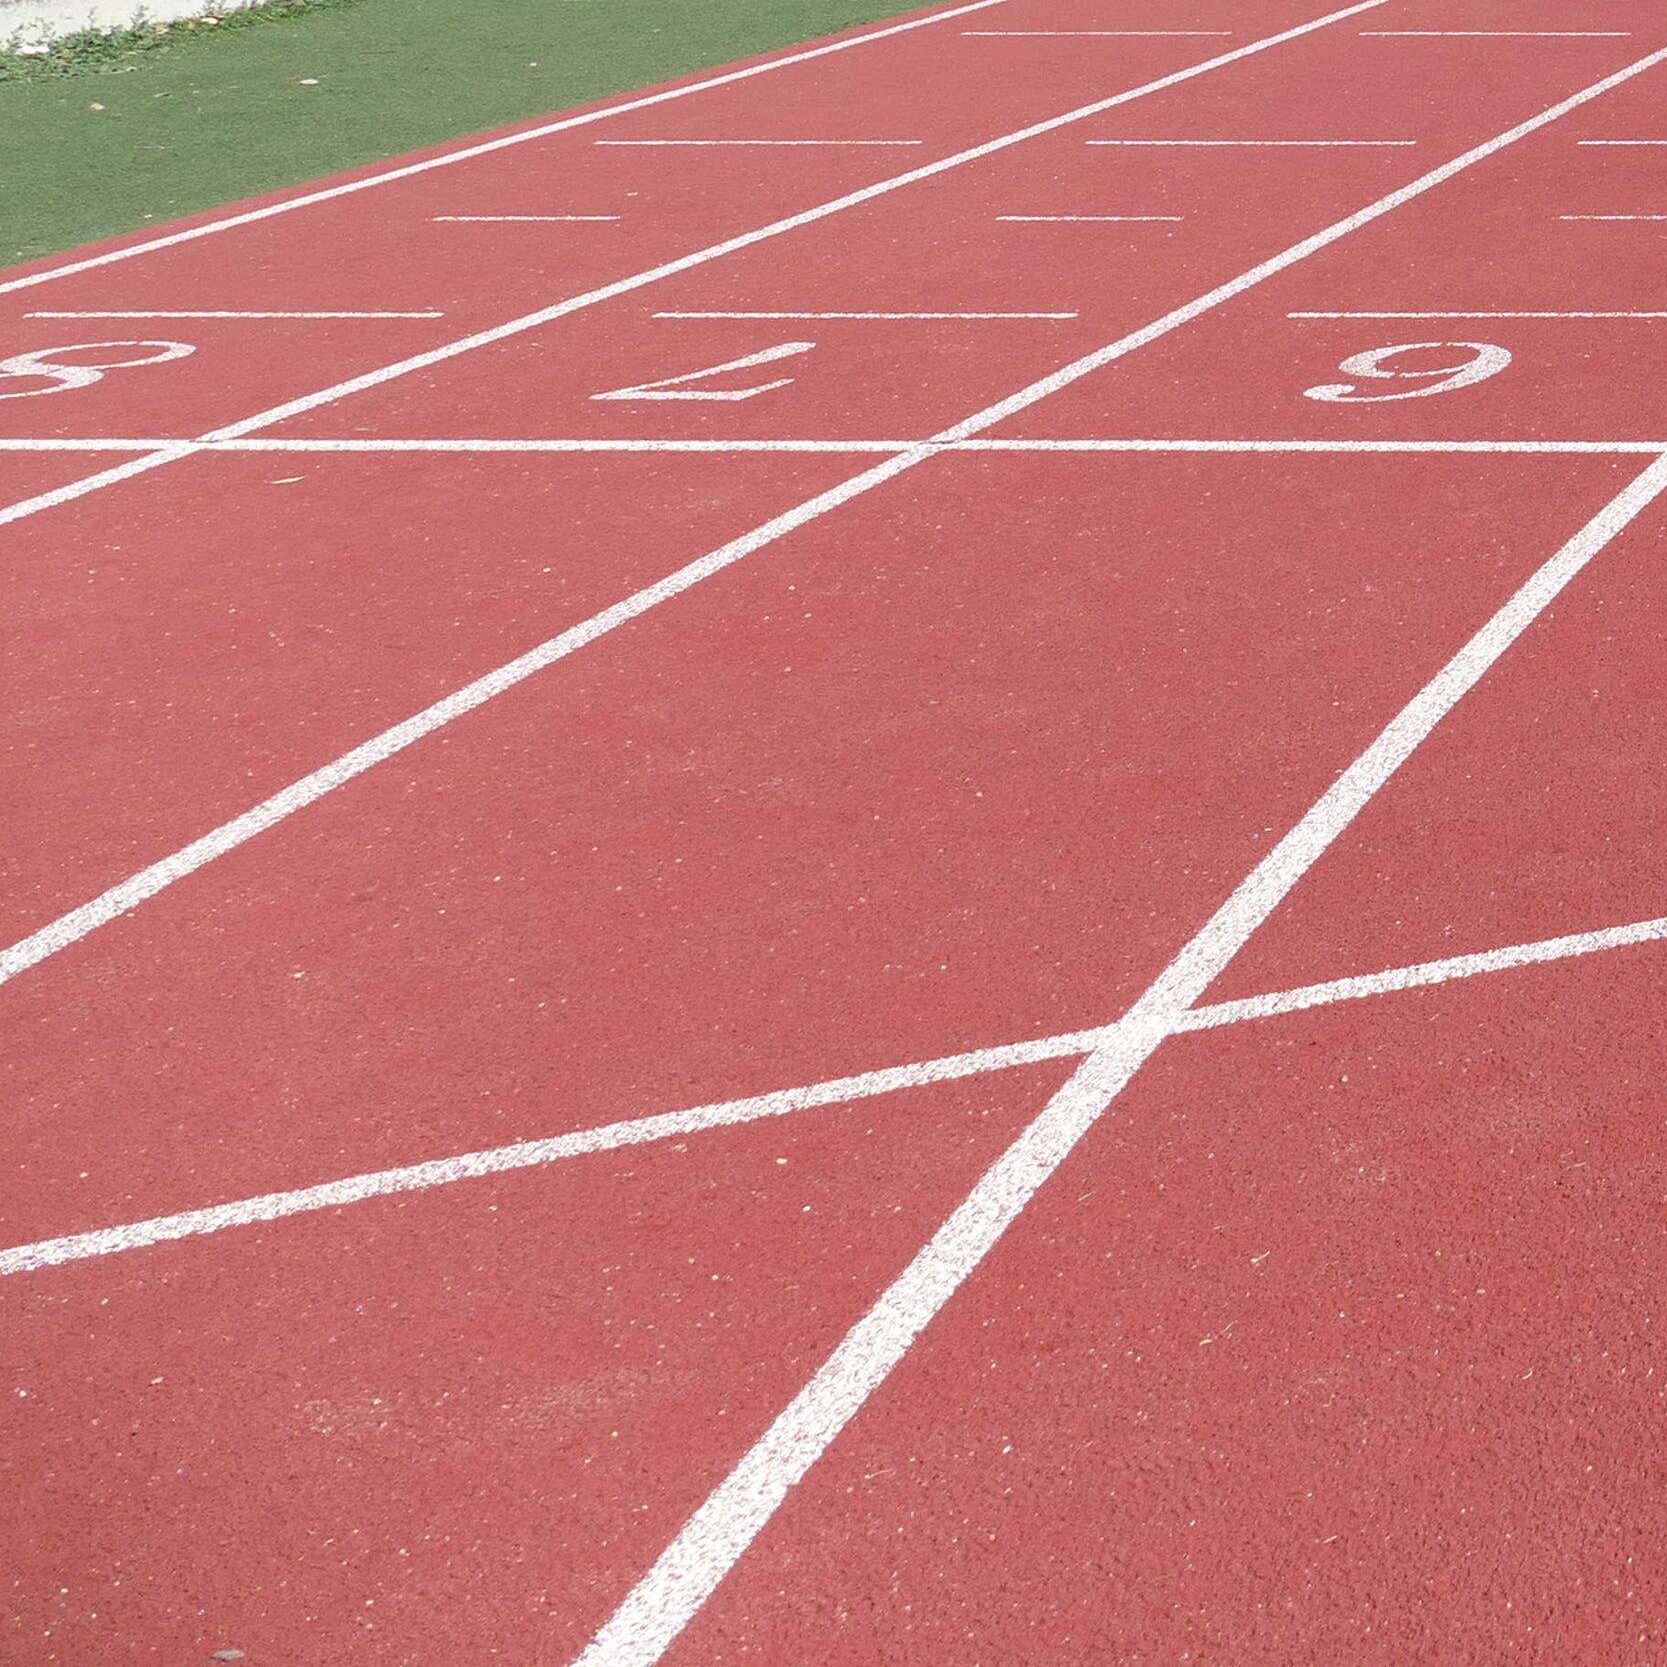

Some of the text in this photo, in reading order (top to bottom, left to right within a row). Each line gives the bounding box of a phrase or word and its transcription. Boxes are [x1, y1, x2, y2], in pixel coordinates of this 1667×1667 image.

[0, 340, 197, 401] 8
[590, 342, 816, 401] 7
[1303, 342, 1512, 402] 6
